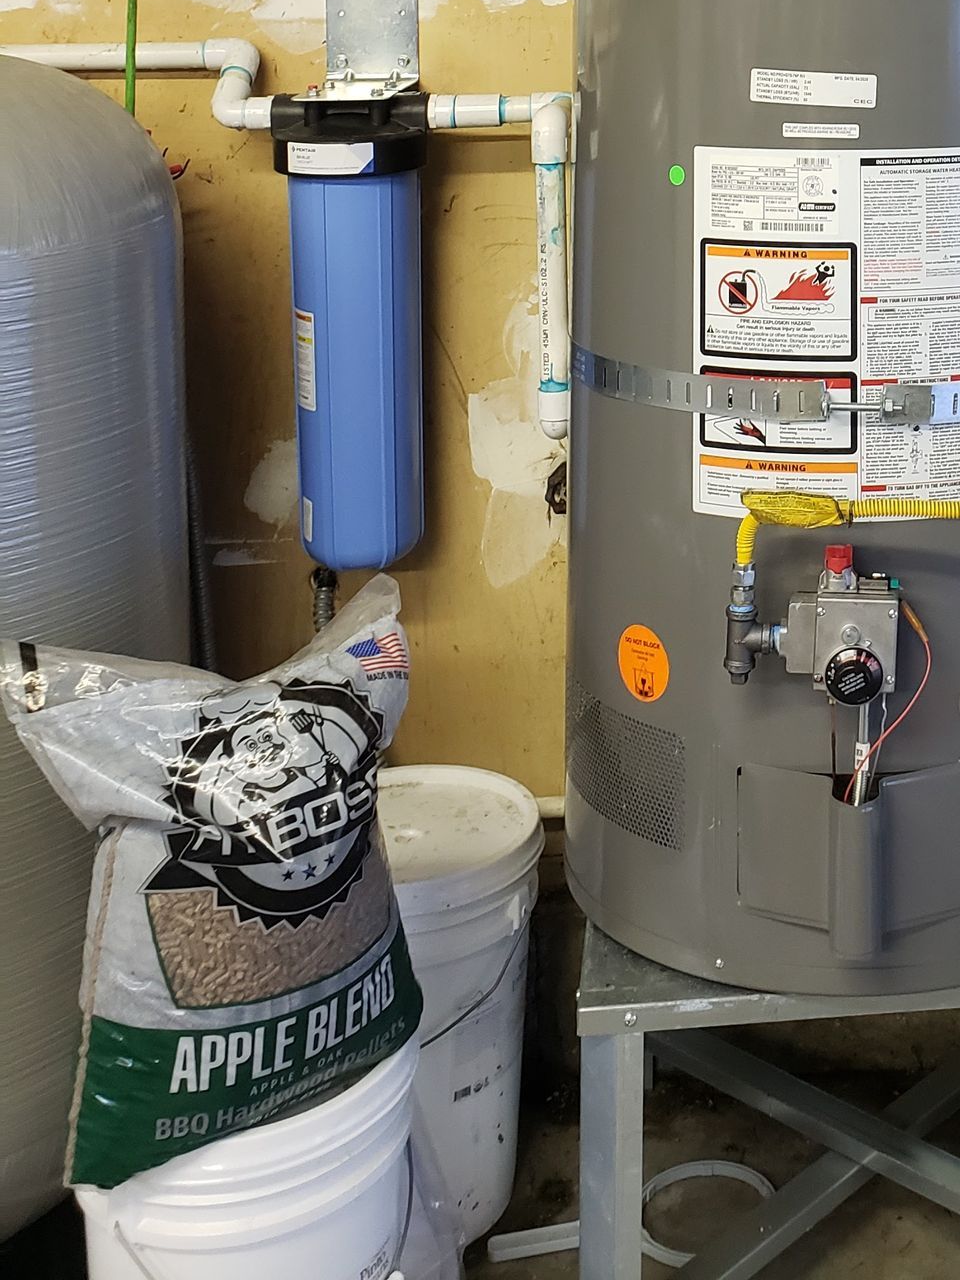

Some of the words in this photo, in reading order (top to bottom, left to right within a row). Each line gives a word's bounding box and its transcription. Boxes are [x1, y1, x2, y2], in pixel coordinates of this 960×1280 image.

[756, 250, 808, 258] WARNING
[758, 462, 806, 472] WARNING
[643, 641, 660, 649] BLOCK
[366, 671, 386, 681] MADE
[387, 671, 394, 679] IN
[394, 670, 402, 679] THE
[169, 1016, 298, 1094] APPLE
[304, 954, 396, 1060] BLEND
[249, 1073, 296, 1097] APPLE
[318, 1048, 344, 1068] OAK
[154, 1116, 210, 1141] BBQ
[215, 1066, 340, 1130] Hardwood
[360, 1251, 387, 1280] Pinto
